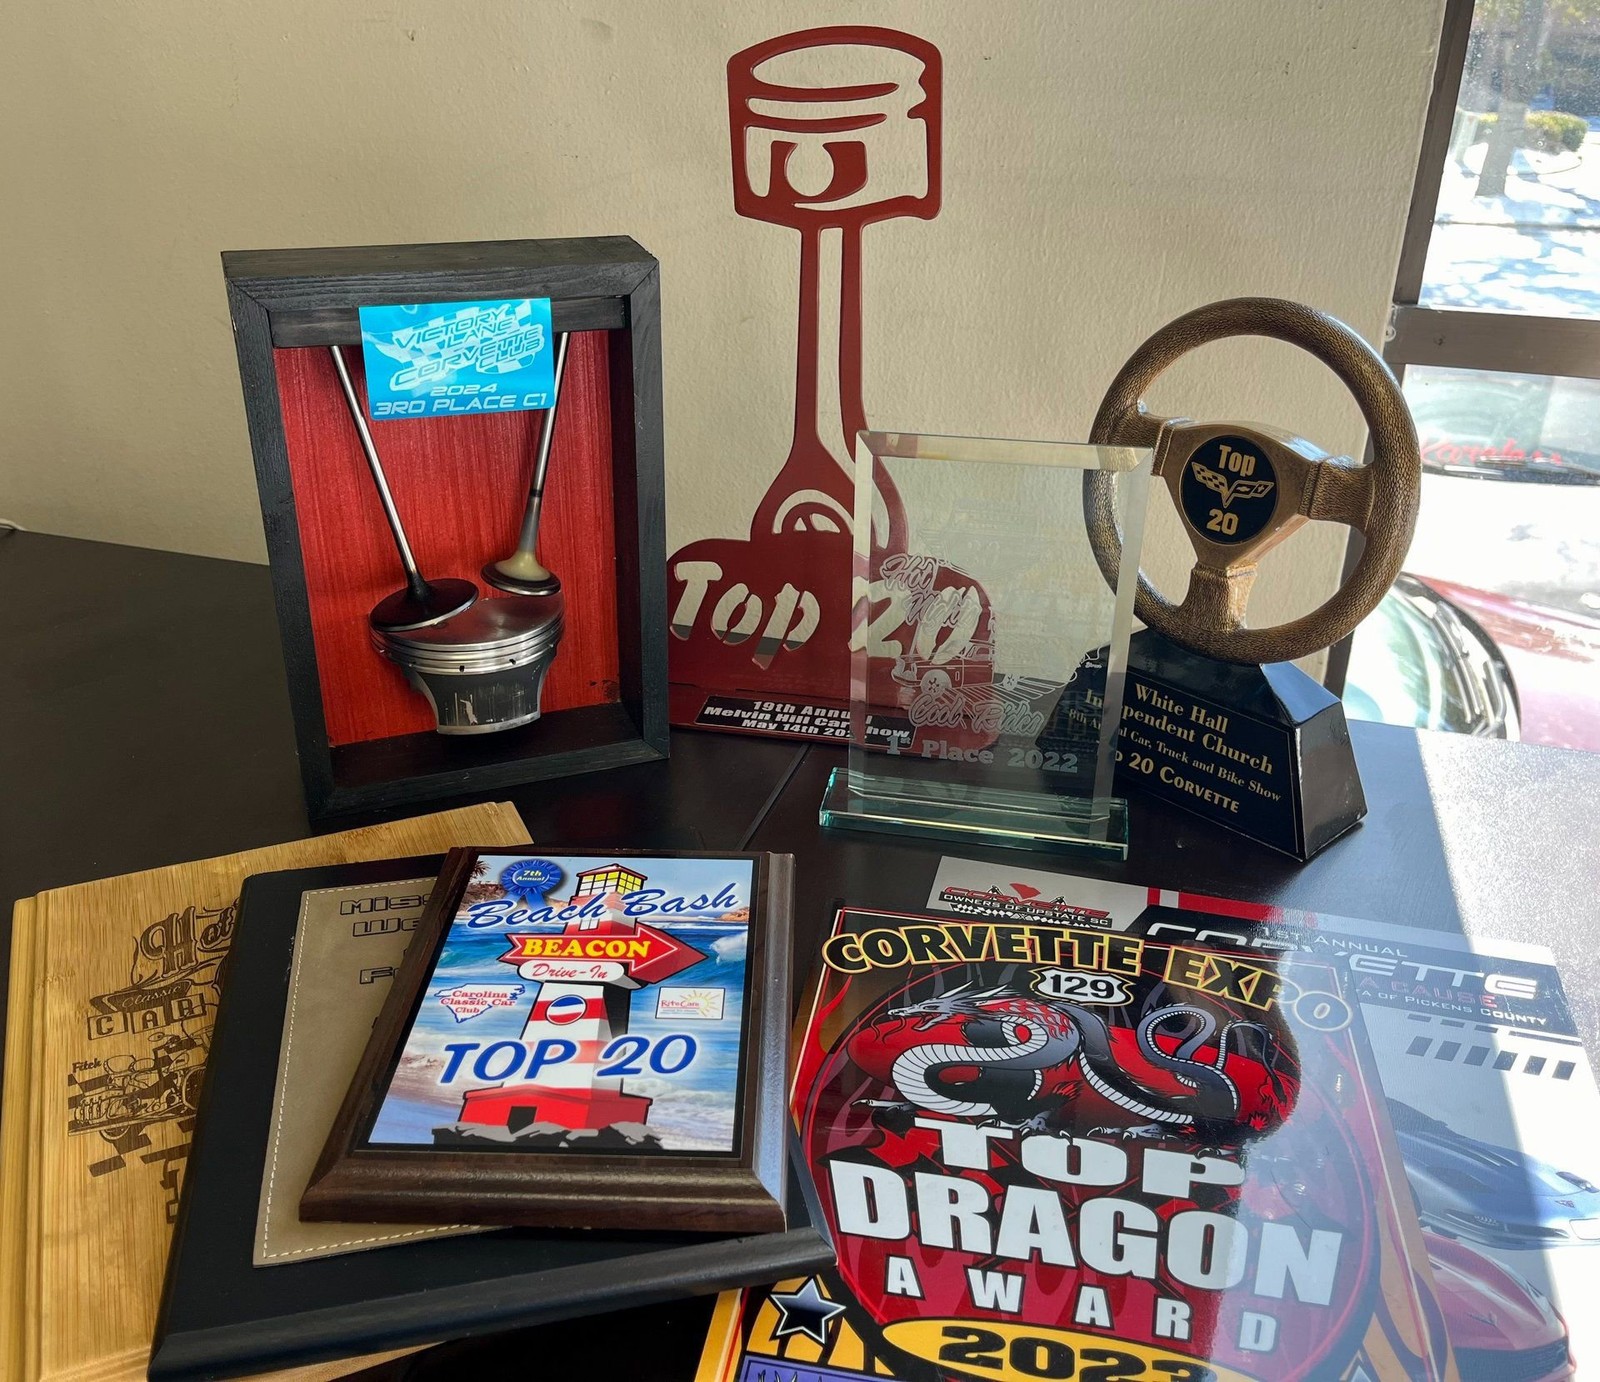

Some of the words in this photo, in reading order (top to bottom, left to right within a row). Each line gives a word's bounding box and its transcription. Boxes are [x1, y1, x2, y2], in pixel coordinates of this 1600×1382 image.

[395, 308, 506, 349] VICTORY
[448, 316, 514, 348] LANE
[398, 328, 541, 385] CORVETTE
[479, 338, 541, 369] CLUB
[373, 400, 426, 416] 3RD
[432, 395, 517, 412] PLACE
[522, 392, 547, 406] C1
[430, 383, 498, 397] 2024
[1217, 444, 1257, 478] Top
[1206, 508, 1240, 536] 20
[669, 561, 821, 670] Top
[848, 576, 983, 667] 20
[704, 706, 770, 721] Melvin
[775, 713, 809, 725] Hill
[814, 718, 851, 729] Car
[864, 725, 910, 738] how
[753, 700, 796, 714] 19th
[799, 704, 873, 725] Annul
[1135, 682, 1185, 716] White
[1189, 705, 1229, 735] Hall
[741, 719, 777, 731] May
[782, 723, 819, 735] 14th
[1085, 688, 1197, 744] Inpendent
[1202, 732, 1274, 775] Church
[921, 739, 995, 765] Place
[1007, 747, 1078, 775] 2022
[1069, 708, 1087, 724] 8th
[1130, 730, 1152, 750] Car,
[1156, 740, 1190, 764] Truck
[1192, 756, 1215, 774] and
[1217, 766, 1246, 787] Bike
[1248, 779, 1282, 803] Show
[1128, 751, 1155, 775] 20
[339, 894, 431, 916] MIS
[466, 891, 607, 929] Beach
[621, 882, 739, 918] Bash
[943, 894, 1000, 908] OWNERS
[1004, 904, 1024, 912] OF
[1025, 907, 1086, 922] UPSTATE
[1090, 917, 1109, 926] SC
[521, 937, 652, 959] BEACON
[1314, 935, 1408, 957] ANNUAL
[532, 962, 608, 980] Drive-In
[822, 922, 1147, 977] CORVETTE
[1161, 944, 1352, 1032] EXPO
[1047, 972, 1116, 1000] 129
[121, 985, 181, 1009] Classic
[440, 997, 487, 1007] Classic
[491, 998, 516, 1007] Car
[452, 990, 508, 999] Carolina
[455, 1006, 480, 1014] Club
[1405, 994, 1473, 1014] PICKENS
[1480, 1007, 1547, 1026] COUNTY
[440, 1038, 577, 1085] TOP
[596, 1033, 698, 1078] 20
[914, 1116, 1246, 1198] TOP
[829, 1159, 1343, 1306] DRAGON
